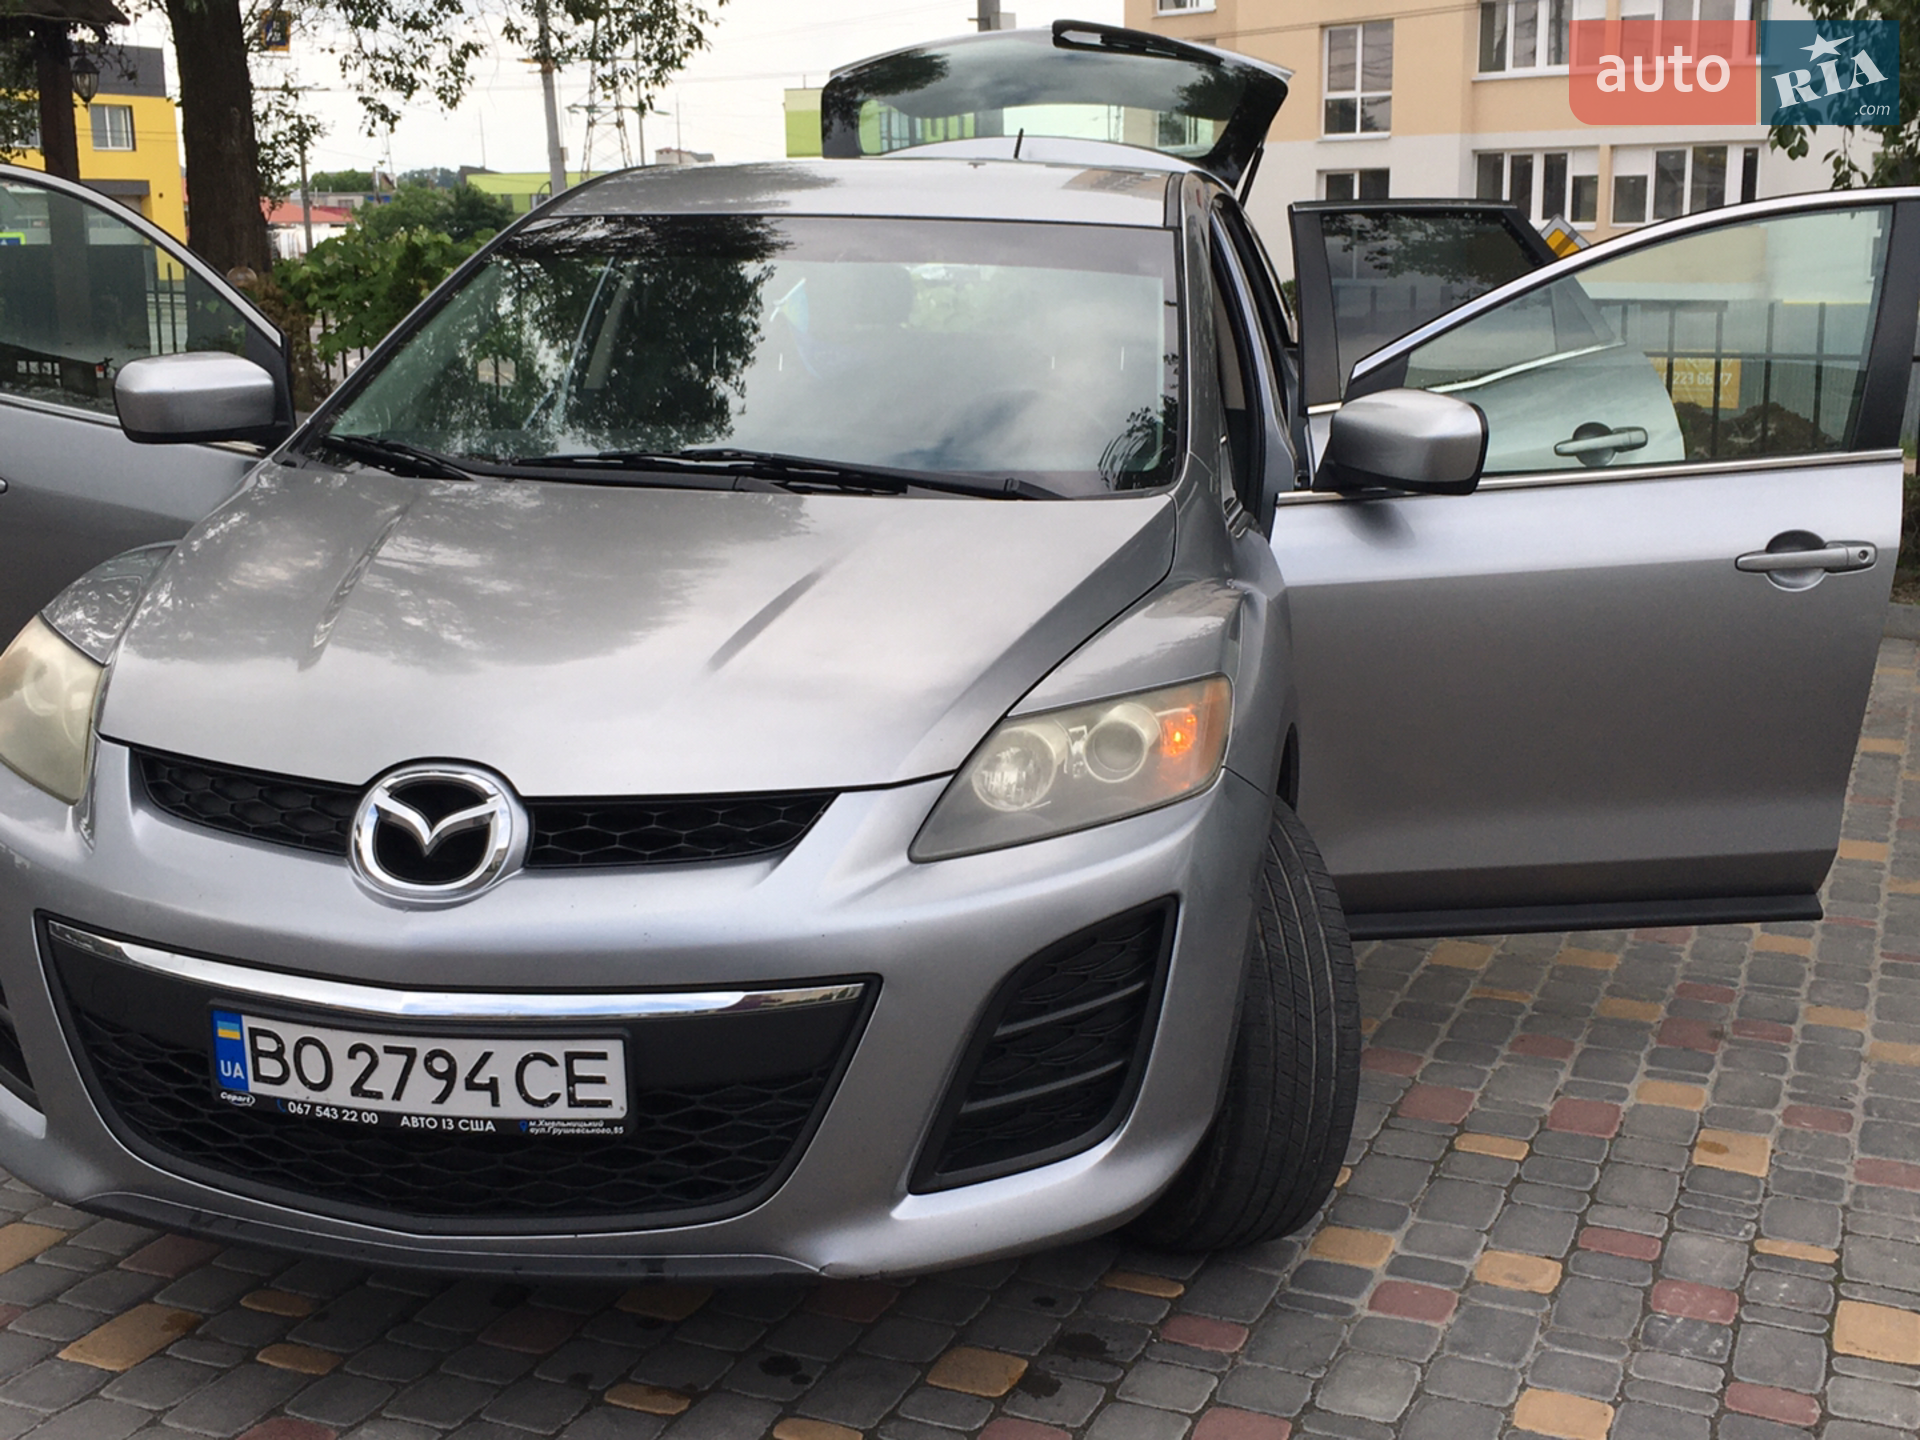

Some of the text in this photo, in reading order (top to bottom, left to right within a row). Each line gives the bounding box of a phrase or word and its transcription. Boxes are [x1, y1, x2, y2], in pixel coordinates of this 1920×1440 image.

[220, 1060, 245, 1080] UA
[248, 1026, 613, 1108] BO 2794 CE
[220, 1091, 251, 1104] Copart
[288, 1101, 379, 1125] 067 543 22 00
[400, 1116, 437, 1129] АВТО
[458, 1119, 496, 1132] США
